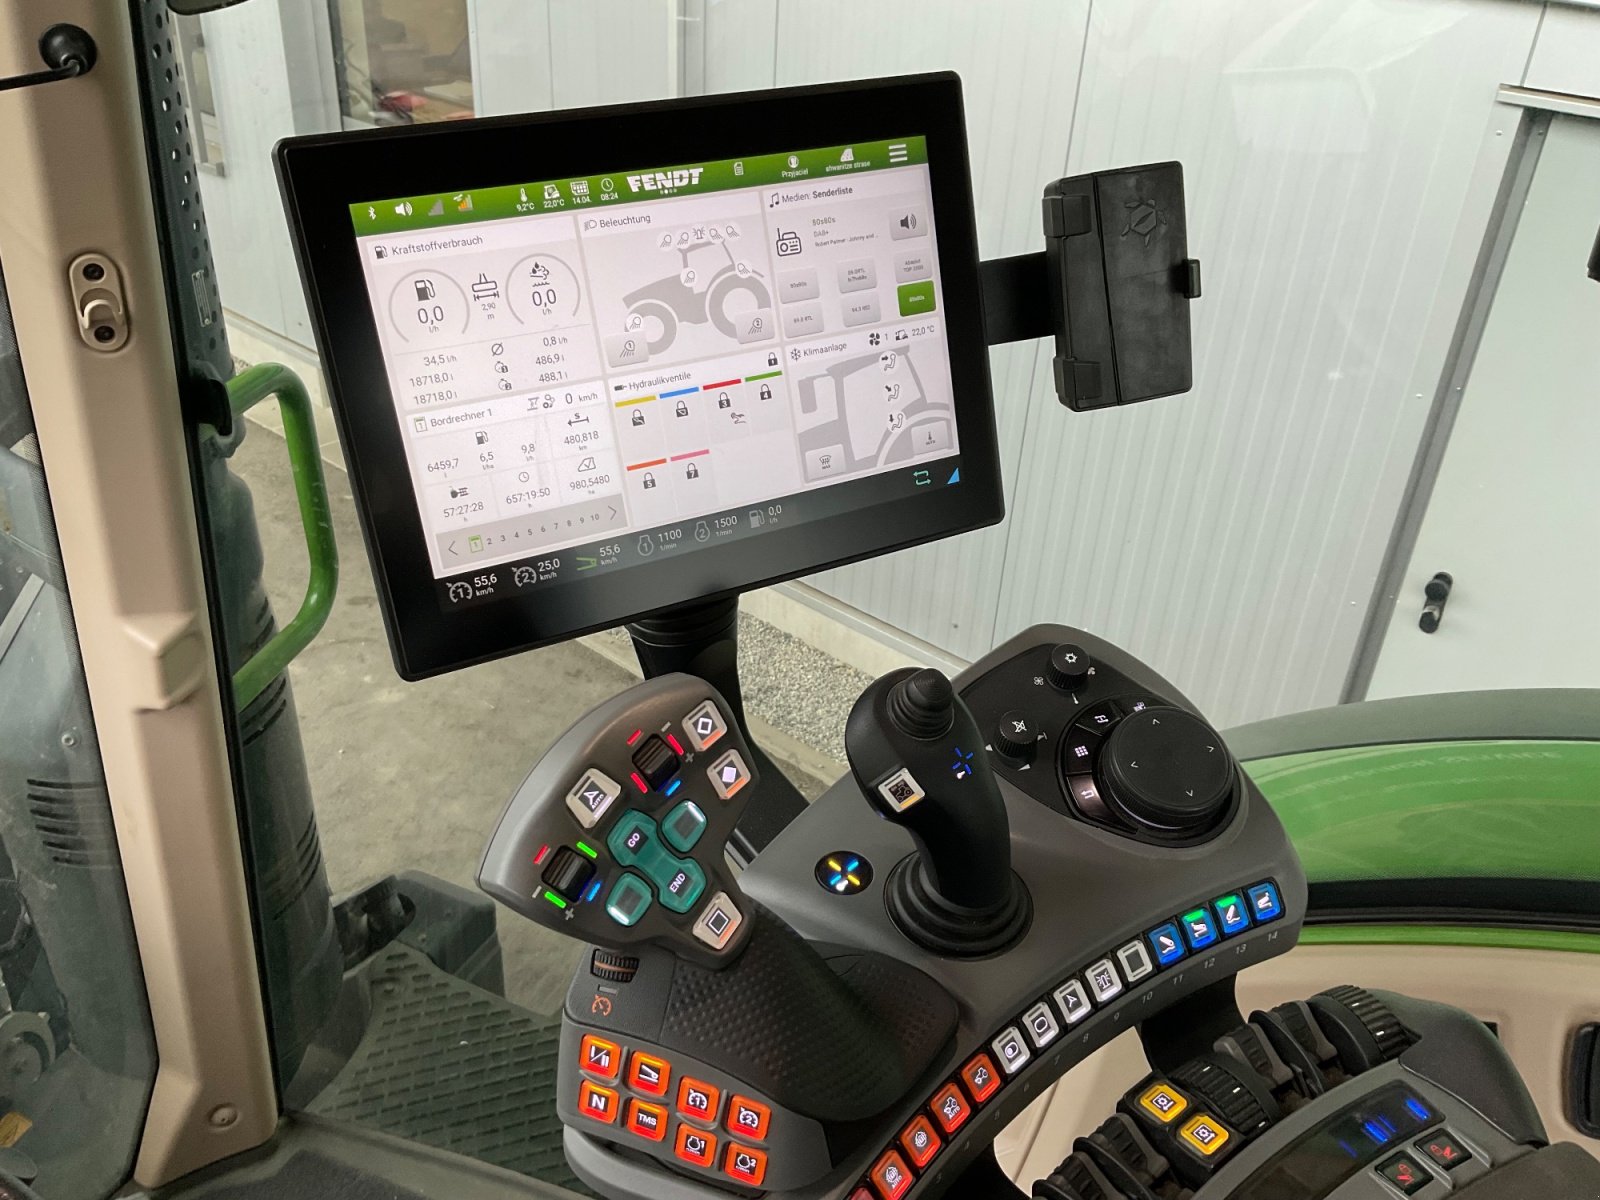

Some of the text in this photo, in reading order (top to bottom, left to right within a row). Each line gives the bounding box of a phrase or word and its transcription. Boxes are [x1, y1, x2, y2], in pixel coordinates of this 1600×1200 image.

[627, 168, 703, 192] FENDT
[601, 193, 618, 201] 08:24
[782, 187, 853, 203] Medien: Senderliste
[600, 215, 651, 228] Beleuchtung
[392, 236, 483, 256] Kraftstoffverbrauch
[532, 289, 557, 309] 0,0
[482, 303, 496, 311] 2,90
[418, 306, 444, 325] 0,0
[912, 327, 926, 337] 22,0
[543, 337, 557, 347] 0,8
[803, 343, 847, 358] Klimaanlage
[424, 355, 445, 367] 34,5
[536, 354, 560, 366] 486,9
[410, 373, 449, 387] 18718,0
[539, 372, 563, 383] 488,1
[629, 371, 692, 390] Hydraulikventile
[414, 391, 453, 405] 18718,0
[565, 393, 598, 404] 0 km/h
[430, 410, 486, 427] Bordrechner
[564, 431, 599, 445] 480,818
[522, 444, 535, 454] 9,8
[480, 452, 494, 463] 6,5
[427, 458, 459, 472] 6459,7
[570, 475, 610, 491] 980,5480
[506, 488, 551, 505] 657:19:50
[444, 502, 484, 517] 57:27:28
[768, 504, 782, 517] 0,0
[715, 516, 738, 528] 1500
[658, 529, 682, 542] 1100
[600, 544, 621, 557] 55,6
[538, 559, 560, 573] 25,0
[474, 574, 498, 588] 55,6
[540, 571, 557, 580] km/h
[476, 587, 494, 596] km/h
[591, 794, 604, 810] AUTO
[627, 832, 640, 847] GO
[669, 873, 685, 892] END
[1269, 931, 1278, 942] 14
[1236, 944, 1246, 954] 13
[1205, 958, 1215, 968] 12
[592, 1094, 605, 1110] N
[639, 1112, 656, 1125] TMS
[949, 1107, 960, 1119] AUTO
[750, 1159, 756, 1167] 2
